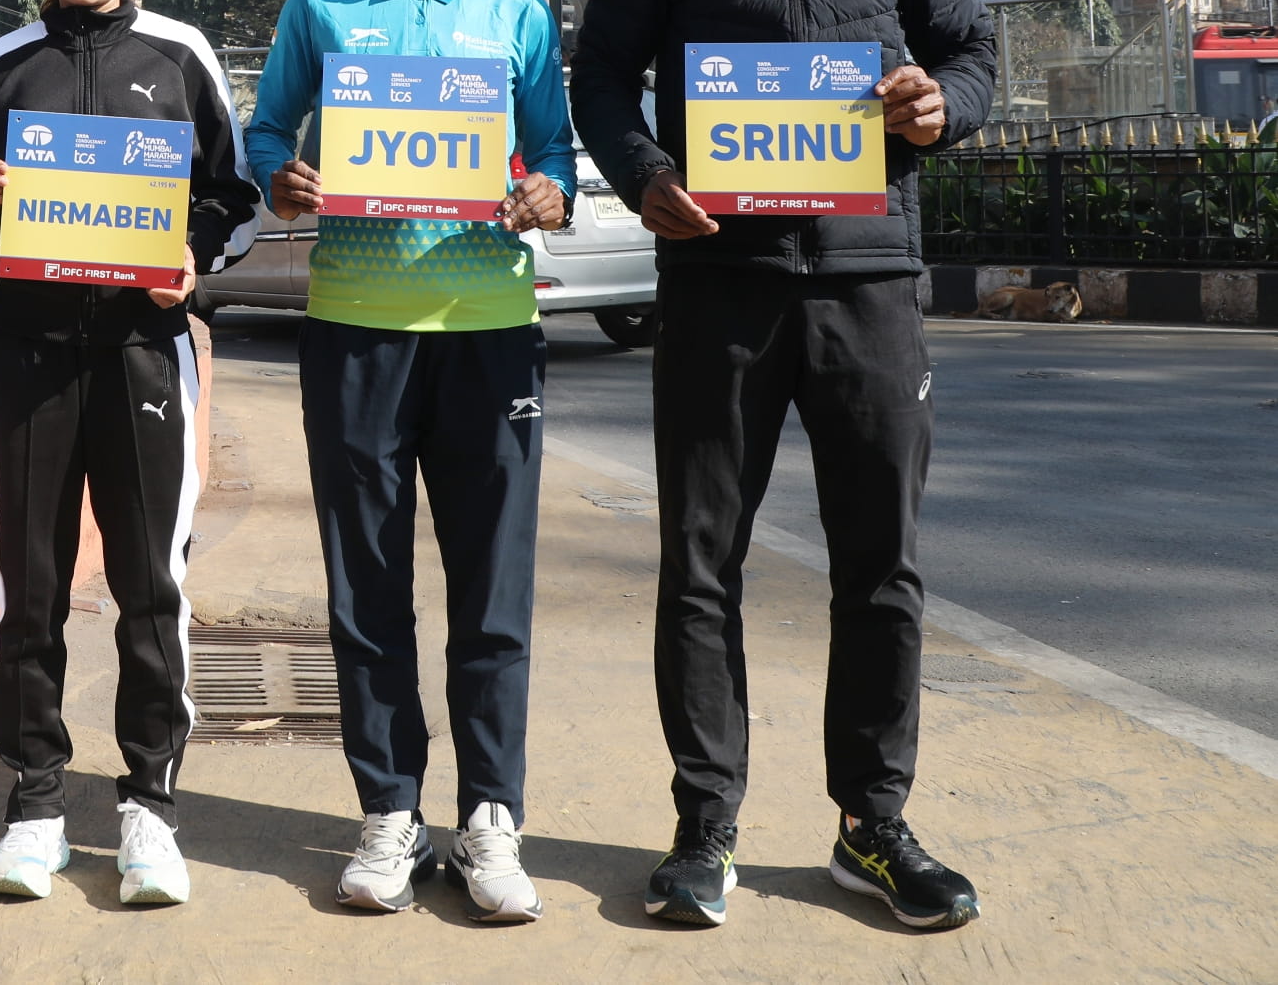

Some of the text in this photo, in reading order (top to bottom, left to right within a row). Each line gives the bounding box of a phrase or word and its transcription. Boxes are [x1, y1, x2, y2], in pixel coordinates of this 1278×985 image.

[830, 60, 854, 68] TATA
[831, 67, 860, 75] MUMBAI
[459, 74, 482, 82] TATA
[831, 74, 872, 82] MARATHON
[460, 87, 498, 95] MARATHON
[695, 81, 739, 93] TATA
[756, 78, 780, 93] tcs
[332, 89, 372, 102] TATA
[390, 89, 412, 102] tcs
[709, 123, 862, 162] SRINU
[16, 148, 56, 162] TATA
[144, 145, 172, 153] MUMBAI
[348, 130, 480, 169] JYOTI
[74, 150, 96, 164] tcs
[144, 151, 182, 160] MARATHON
[383, 204, 458, 214] IDFC FIRST Bank
[755, 200, 835, 209] IDFC FIRST Bank
[18, 199, 172, 231] NIRMABEN
[62, 267, 136, 280] IDFC FIRST Bank
